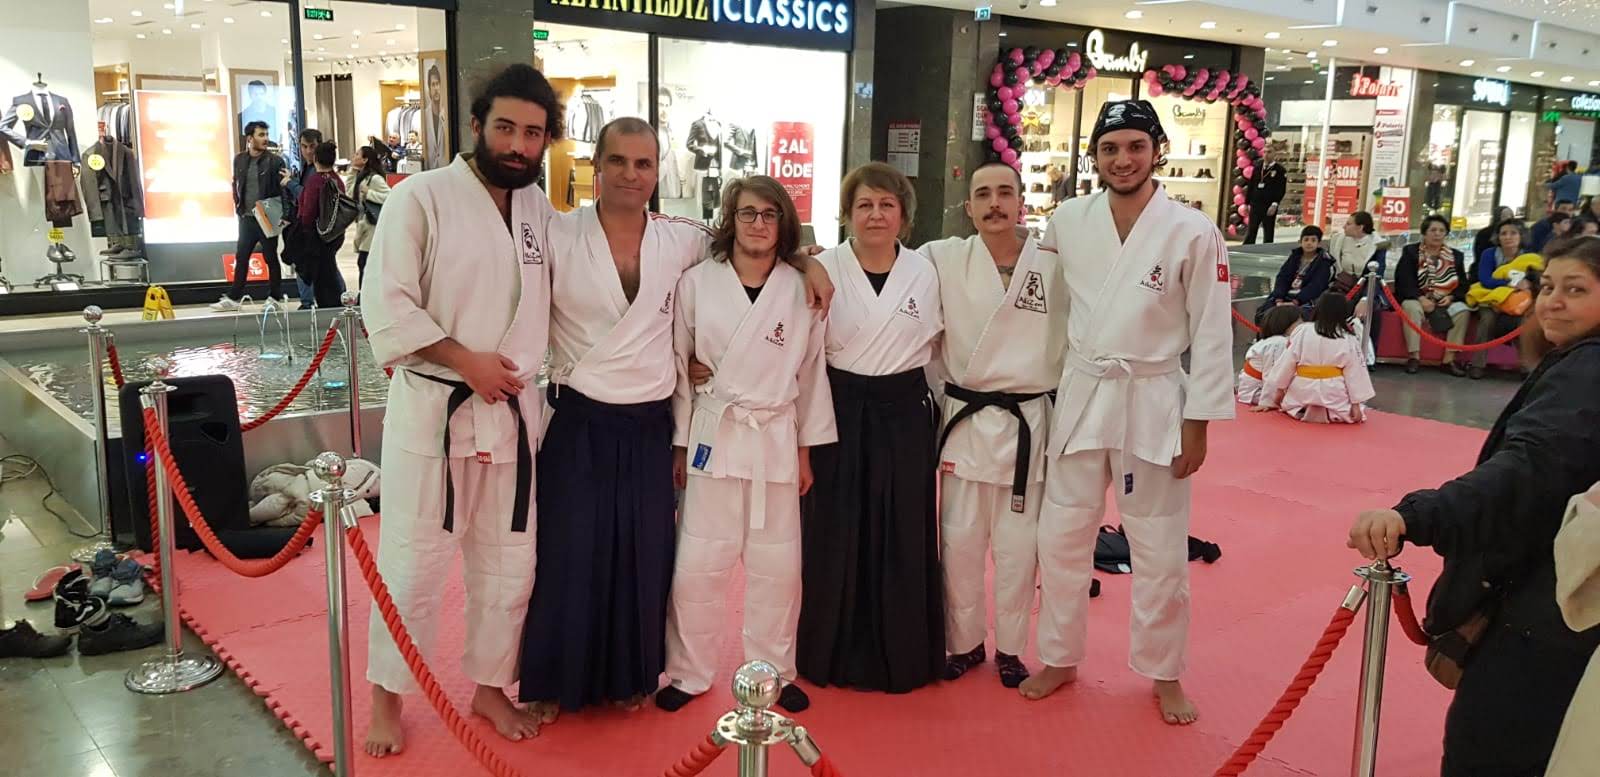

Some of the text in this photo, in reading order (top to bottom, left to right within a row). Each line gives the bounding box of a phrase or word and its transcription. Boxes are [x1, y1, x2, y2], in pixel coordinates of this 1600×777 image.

[722, 0, 848, 34] CLASSICS
[1086, 29, 1148, 73] Bambi
[1359, 76, 1401, 97] Polaris
[778, 139, 809, 154] 2 AL
[772, 156, 813, 178] 1 ÖDE
[1337, 166, 1360, 179] SON
